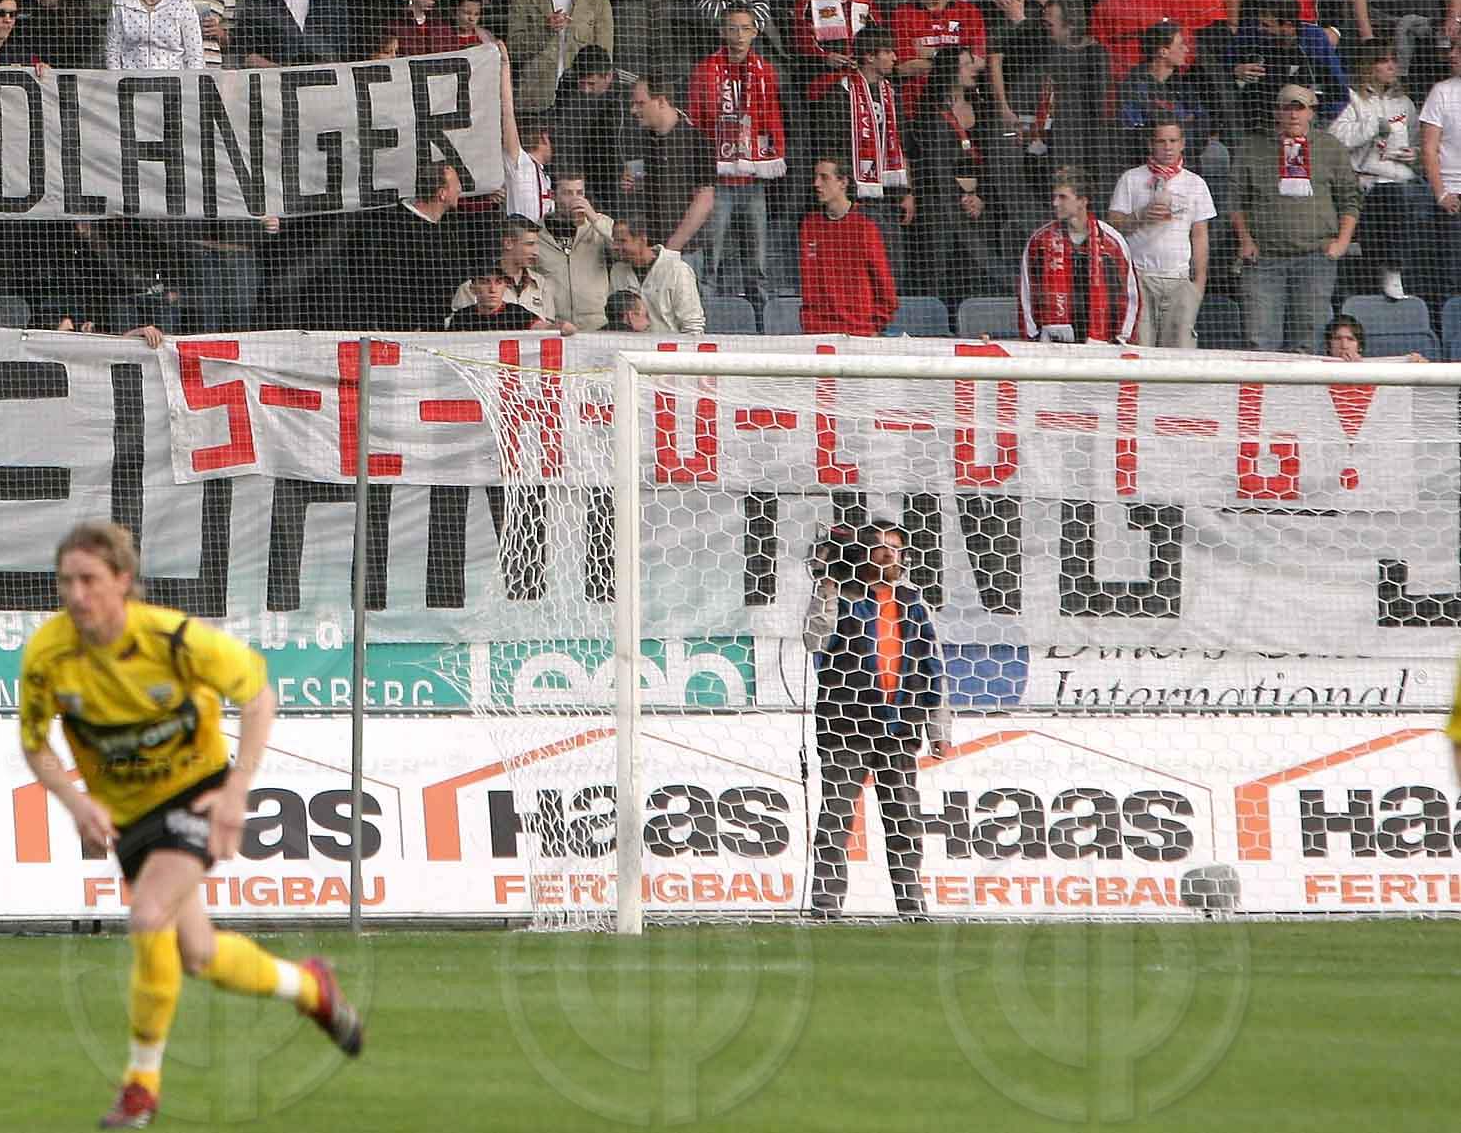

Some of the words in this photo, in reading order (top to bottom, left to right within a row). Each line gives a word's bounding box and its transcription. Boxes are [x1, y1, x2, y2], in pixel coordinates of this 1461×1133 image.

[1052, 668, 1410, 718] International
[487, 784, 790, 860] Haas
[1299, 785, 1461, 860] Ha
[83, 875, 386, 907] FTIGBAU
[493, 872, 795, 904] FERIGBAU
